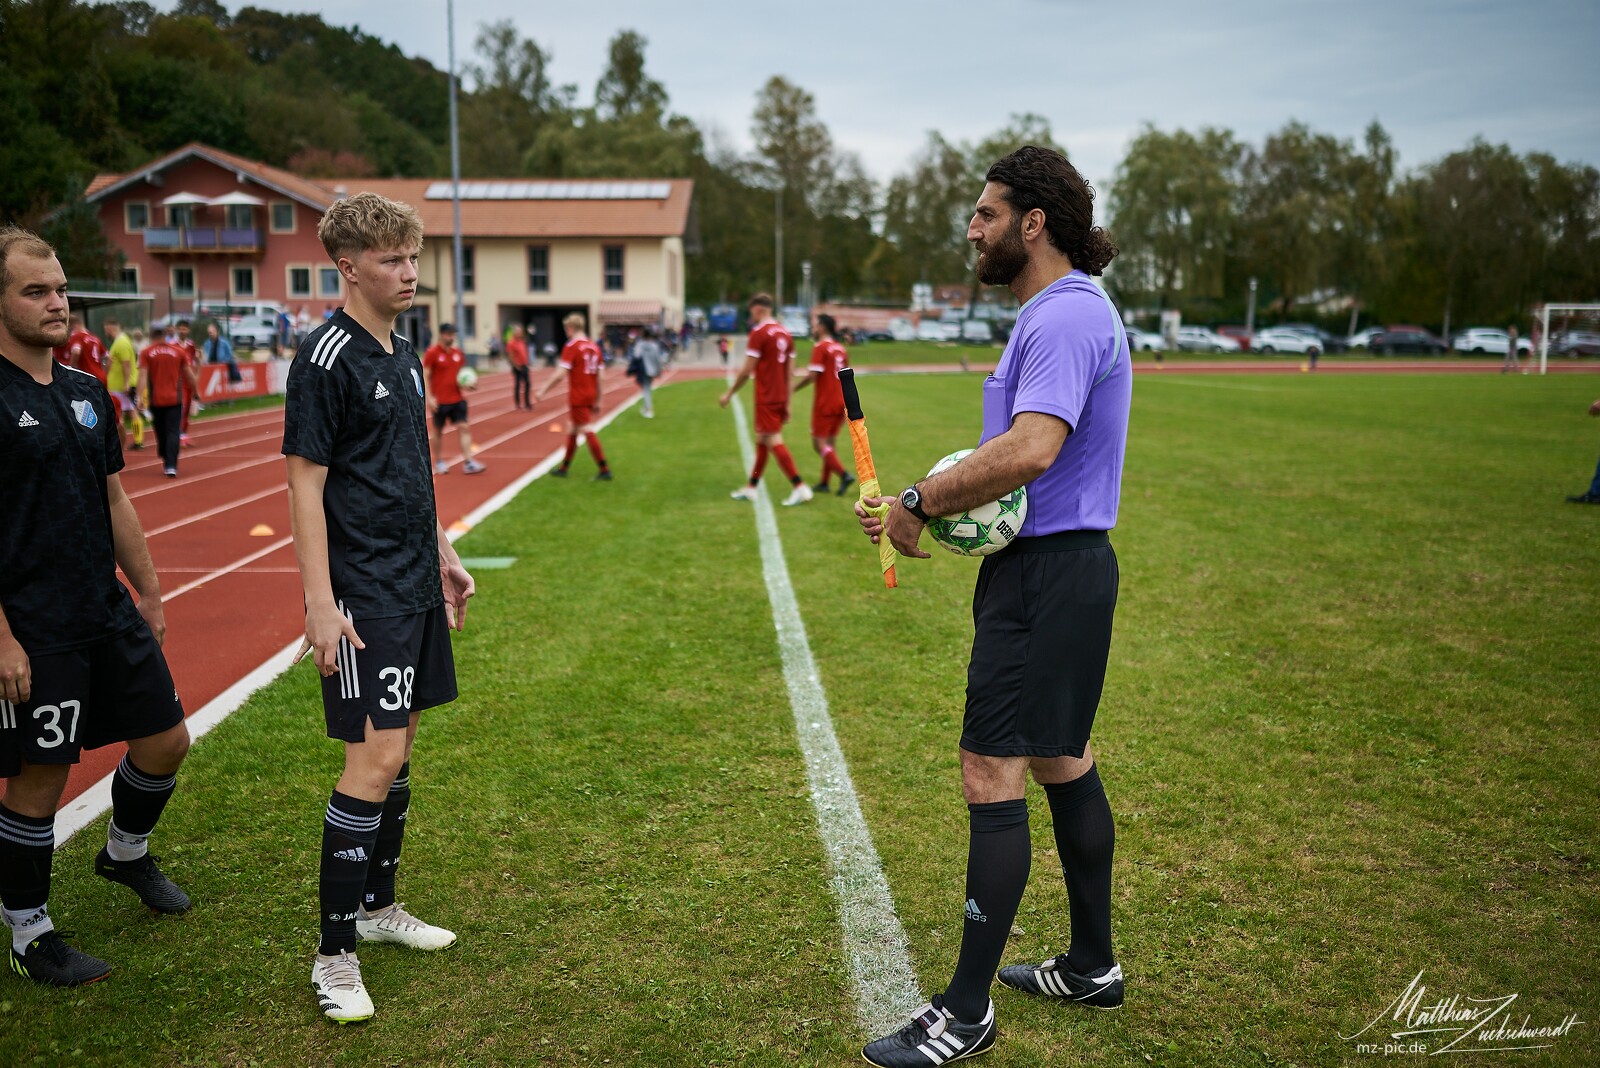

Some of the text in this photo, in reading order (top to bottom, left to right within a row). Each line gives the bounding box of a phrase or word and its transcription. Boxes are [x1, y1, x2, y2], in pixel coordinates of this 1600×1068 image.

[379, 666, 415, 711] 38
[33, 700, 81, 748] 37
[333, 852, 368, 862] adidas
[21, 913, 48, 927] adida
[964, 909, 987, 923] das
